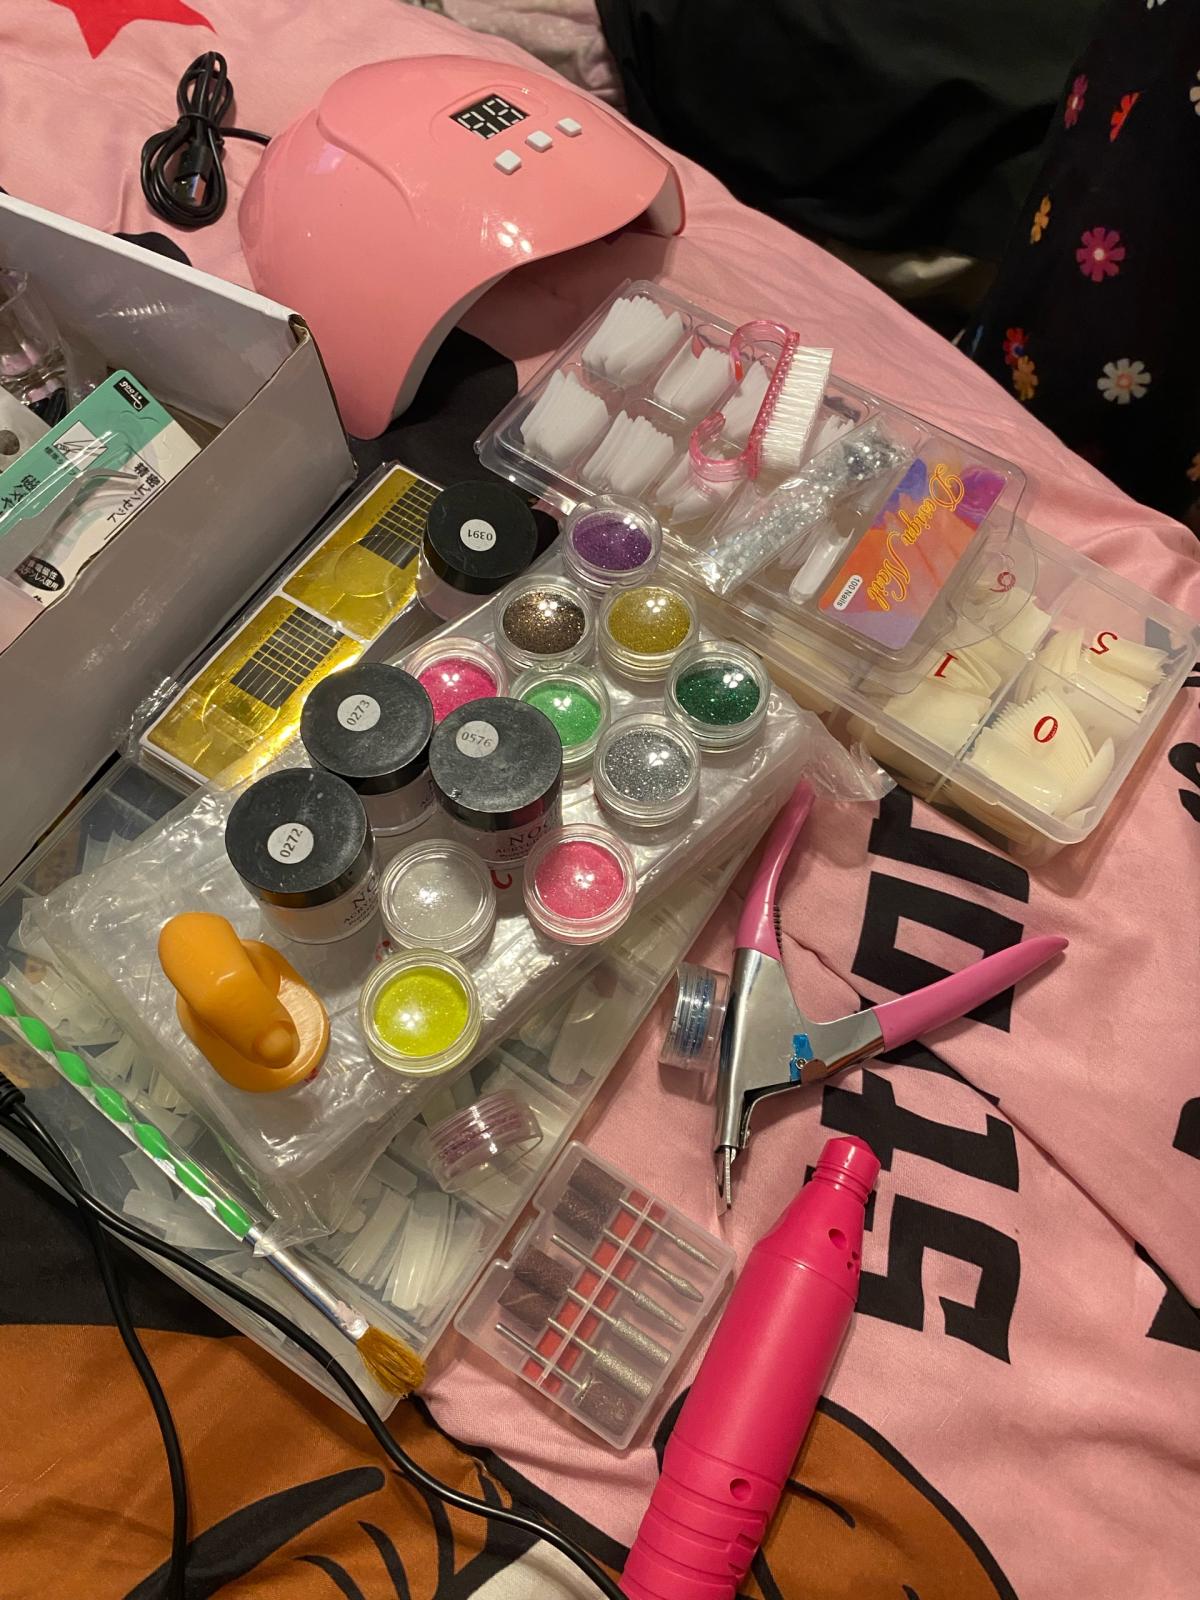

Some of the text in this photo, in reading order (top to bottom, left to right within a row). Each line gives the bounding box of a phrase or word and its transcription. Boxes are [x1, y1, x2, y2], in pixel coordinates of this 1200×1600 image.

[467, 529, 493, 541] 0391
[867, 464, 965, 610] Design Nail
[836, 578, 860, 607] 100 Nails
[1089, 631, 1118, 655] 5
[934, 652, 959, 679] 1
[345, 699, 371, 727] 0273
[461, 730, 493, 749] 0576
[1033, 716, 1059, 744] 0
[279, 827, 304, 859] 0272
